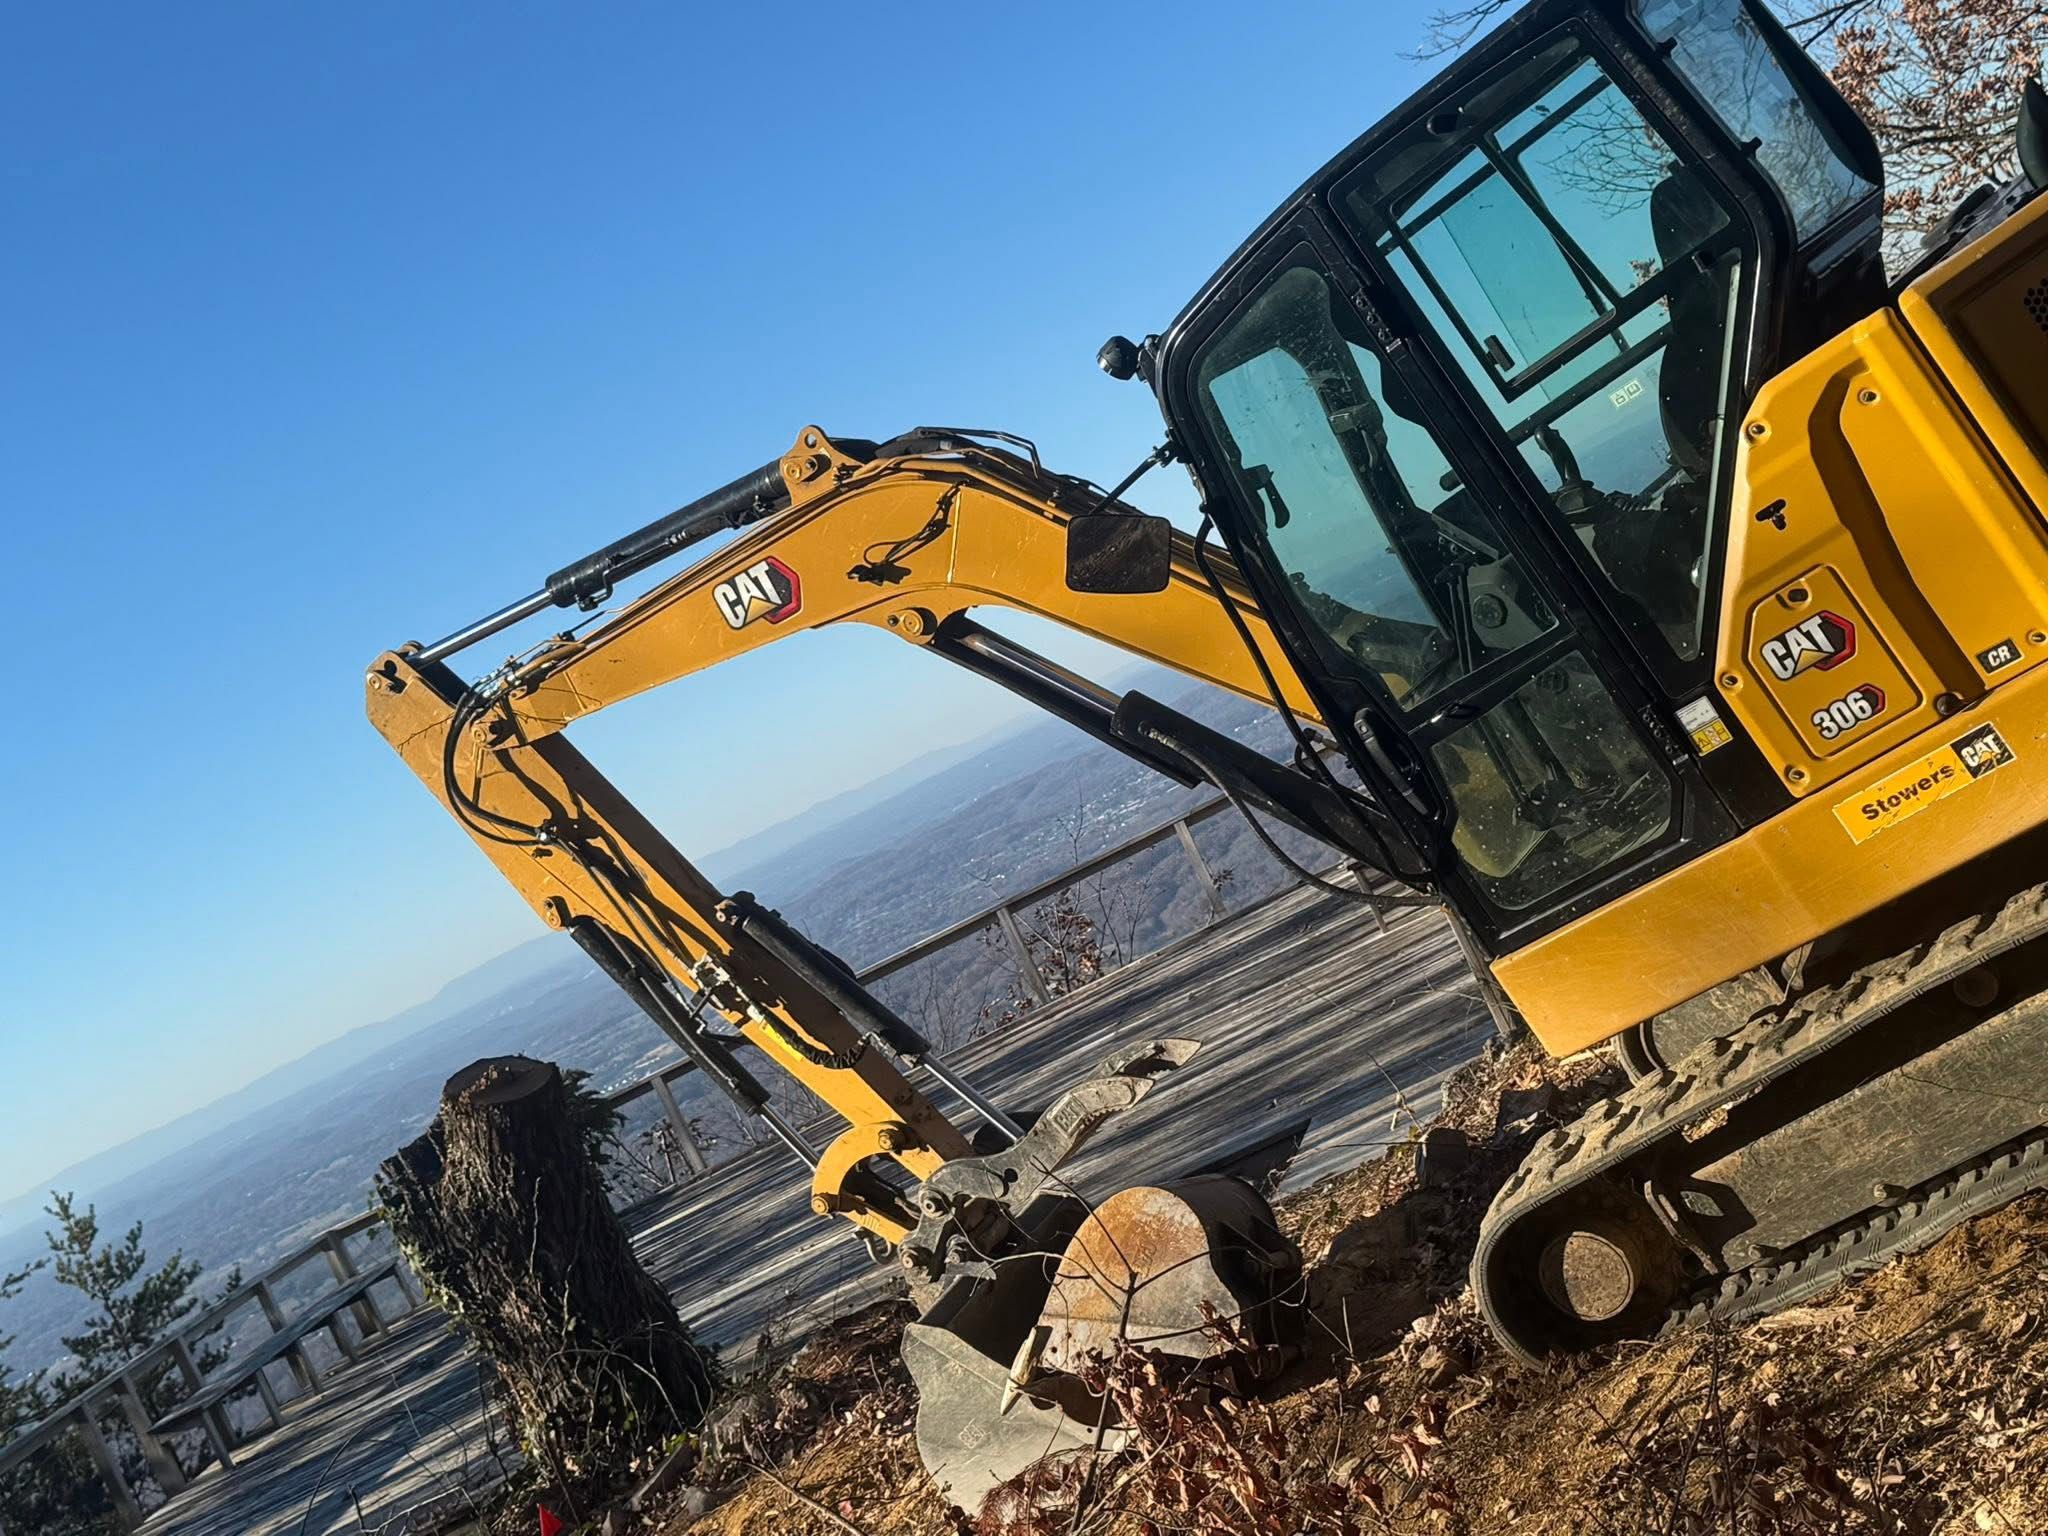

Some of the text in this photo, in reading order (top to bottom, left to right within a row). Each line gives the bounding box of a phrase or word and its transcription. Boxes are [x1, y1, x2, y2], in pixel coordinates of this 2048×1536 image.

[713, 560, 783, 629] CAT
[1761, 615, 1836, 680] CAT
[1987, 645, 2012, 667] CR
[1812, 691, 1873, 739] 306
[1861, 733, 2002, 821] Stowers CAT
